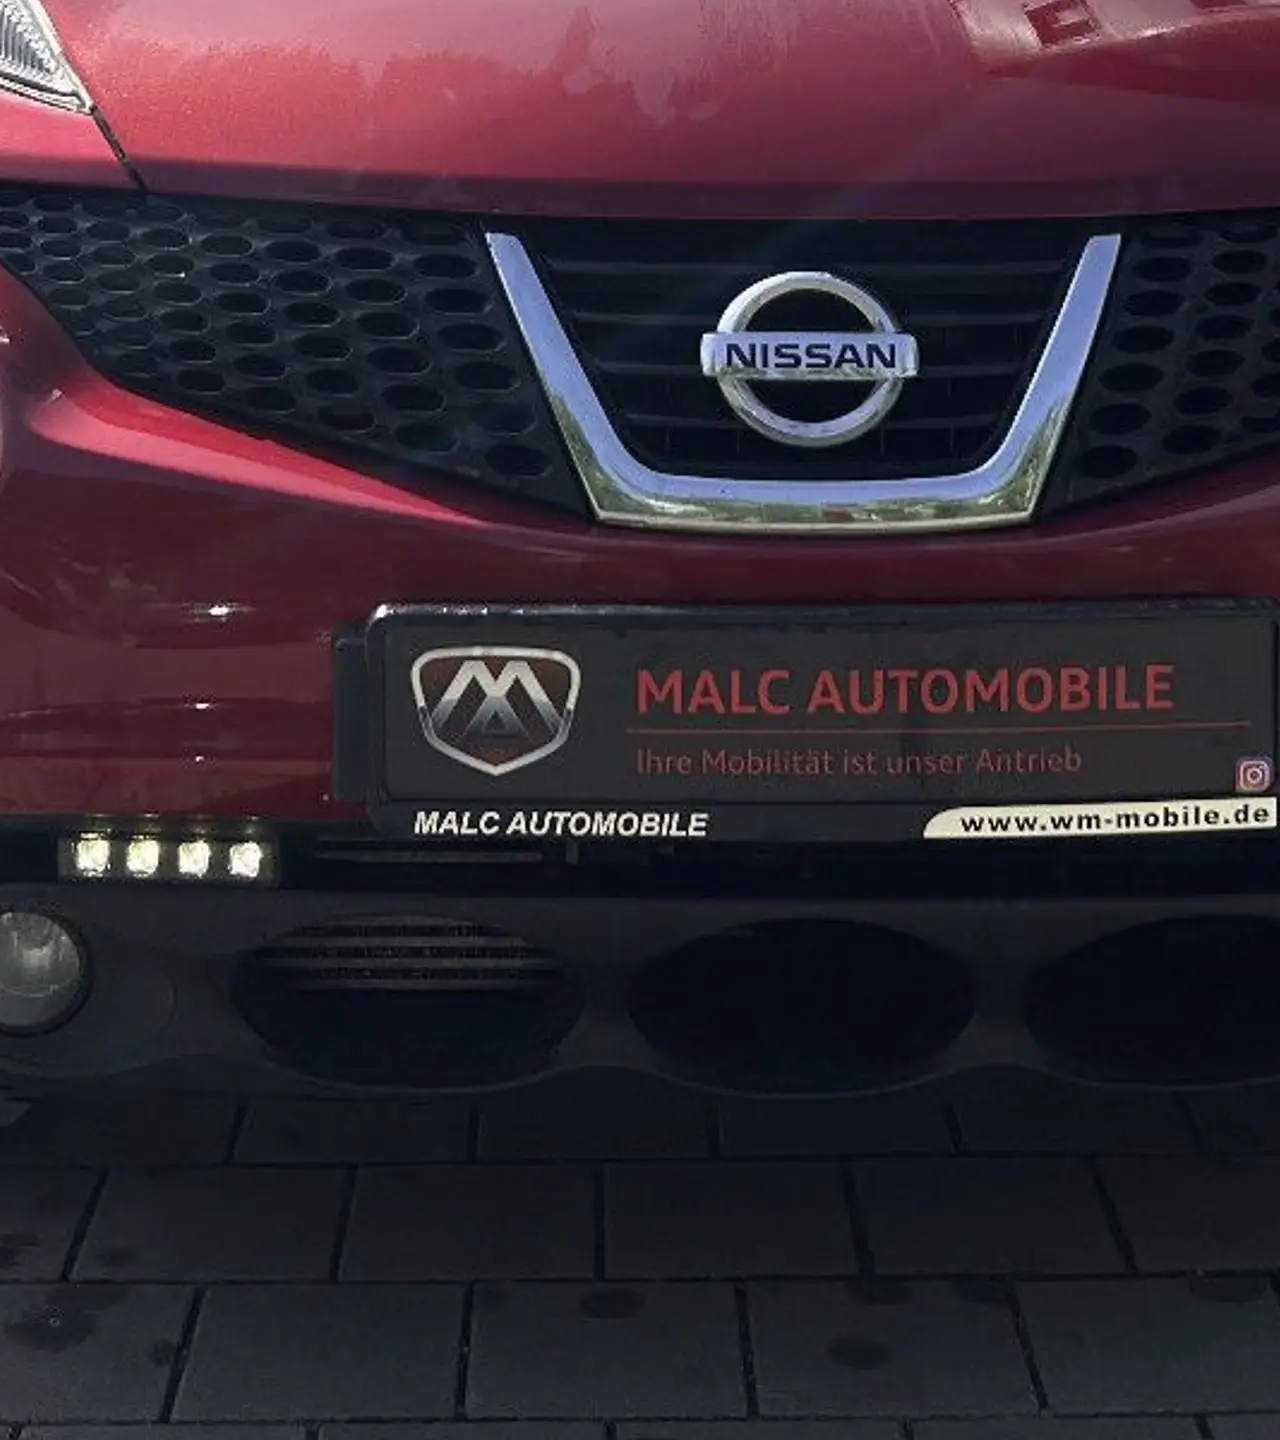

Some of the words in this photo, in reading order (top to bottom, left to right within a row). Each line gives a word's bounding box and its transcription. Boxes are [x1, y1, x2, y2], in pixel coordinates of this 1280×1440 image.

[725, 343, 897, 370] NISSAN
[637, 668, 790, 714] MALC
[807, 663, 1175, 715] AUTOMOBILE
[636, 748, 692, 776] Ihre
[701, 748, 834, 776] Mobilität
[842, 748, 880, 776] ist
[887, 752, 965, 775] unser
[975, 744, 1083, 775] Antrieb
[413, 810, 500, 836] MALC
[506, 811, 709, 837] AUTOMOBILE
[961, 803, 1271, 833] www.wm-mobile.de
